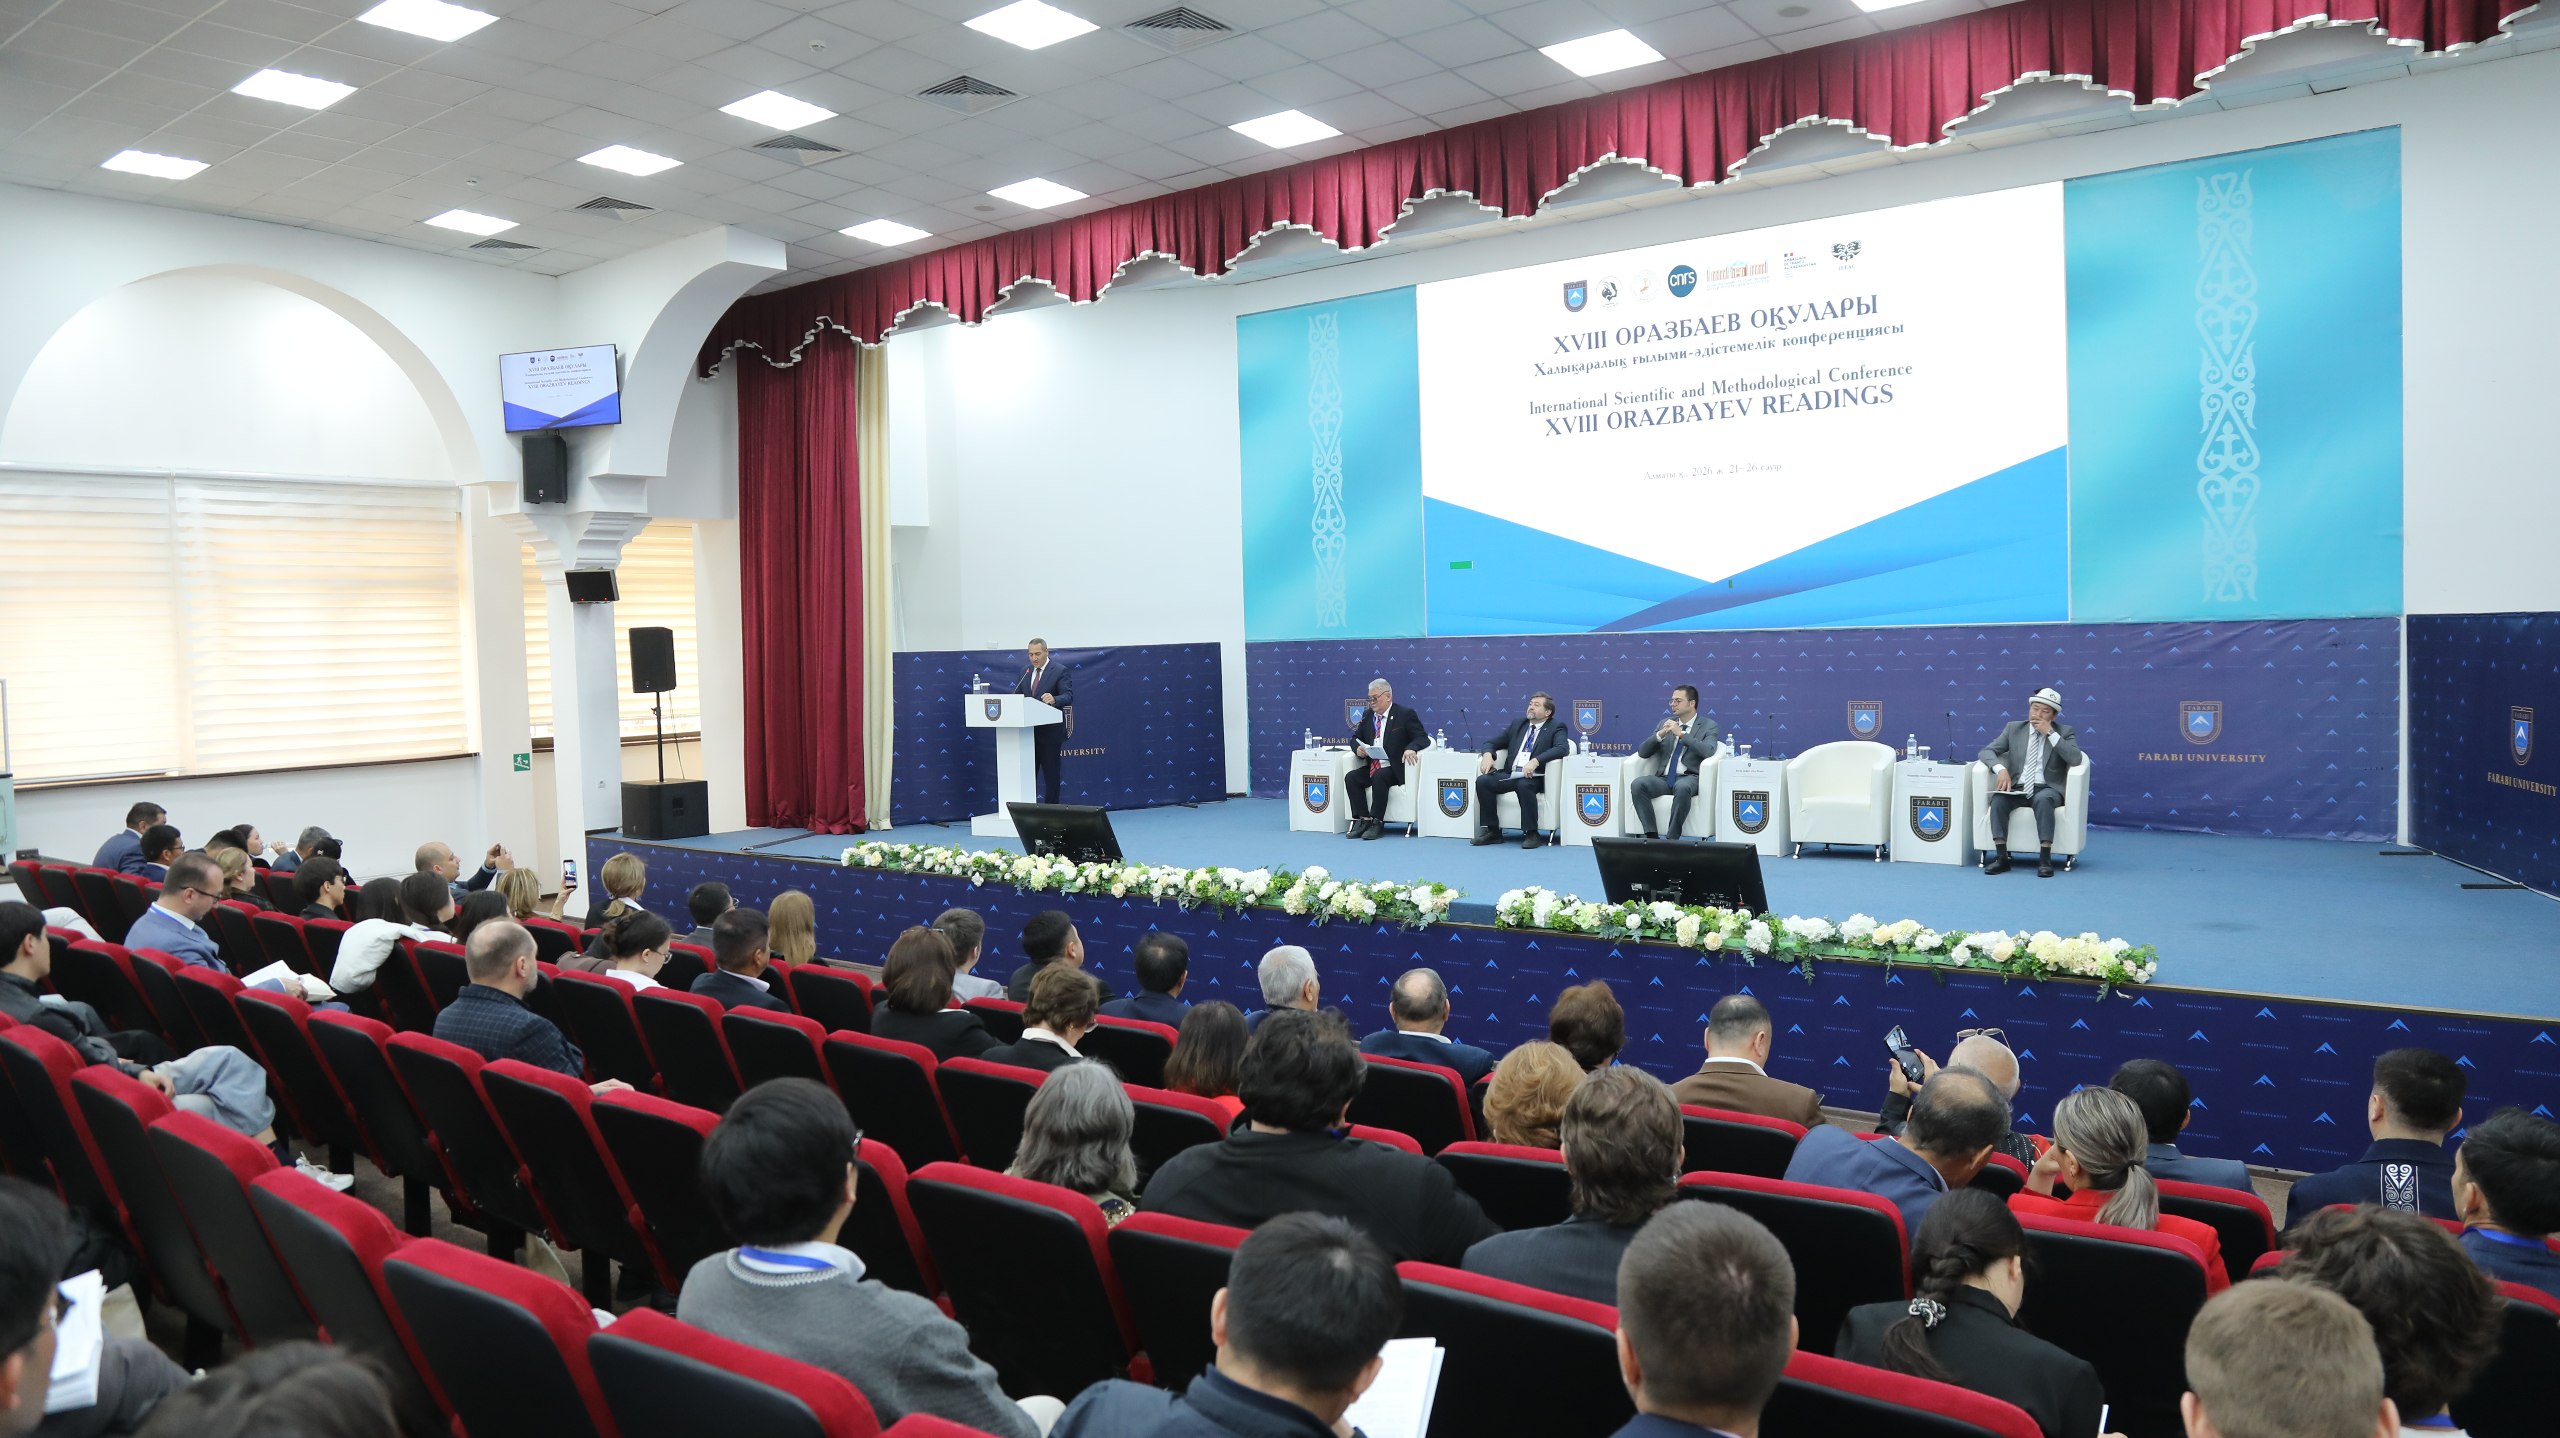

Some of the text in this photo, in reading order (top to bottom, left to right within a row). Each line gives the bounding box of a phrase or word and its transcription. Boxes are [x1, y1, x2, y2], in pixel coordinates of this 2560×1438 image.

[1670, 271, 1696, 287] cnrs
[1553, 294, 1878, 354] XVIII ОРАЗБАЕВ ОҚУЛАРЫ
[1534, 357, 1627, 376] Халықаралық
[1782, 323, 1904, 348] конференциясы
[1529, 364, 1913, 415] International Scientific and Methodological Conference
[1545, 383, 1894, 437] XVIII ORAZBAYEV READINGS
[1060, 747, 1106, 757] IVERSITY
[2138, 752, 2266, 763] FARABI UNIVERSITY
[2487, 771, 2558, 797] FARABI UNIVERSITY
